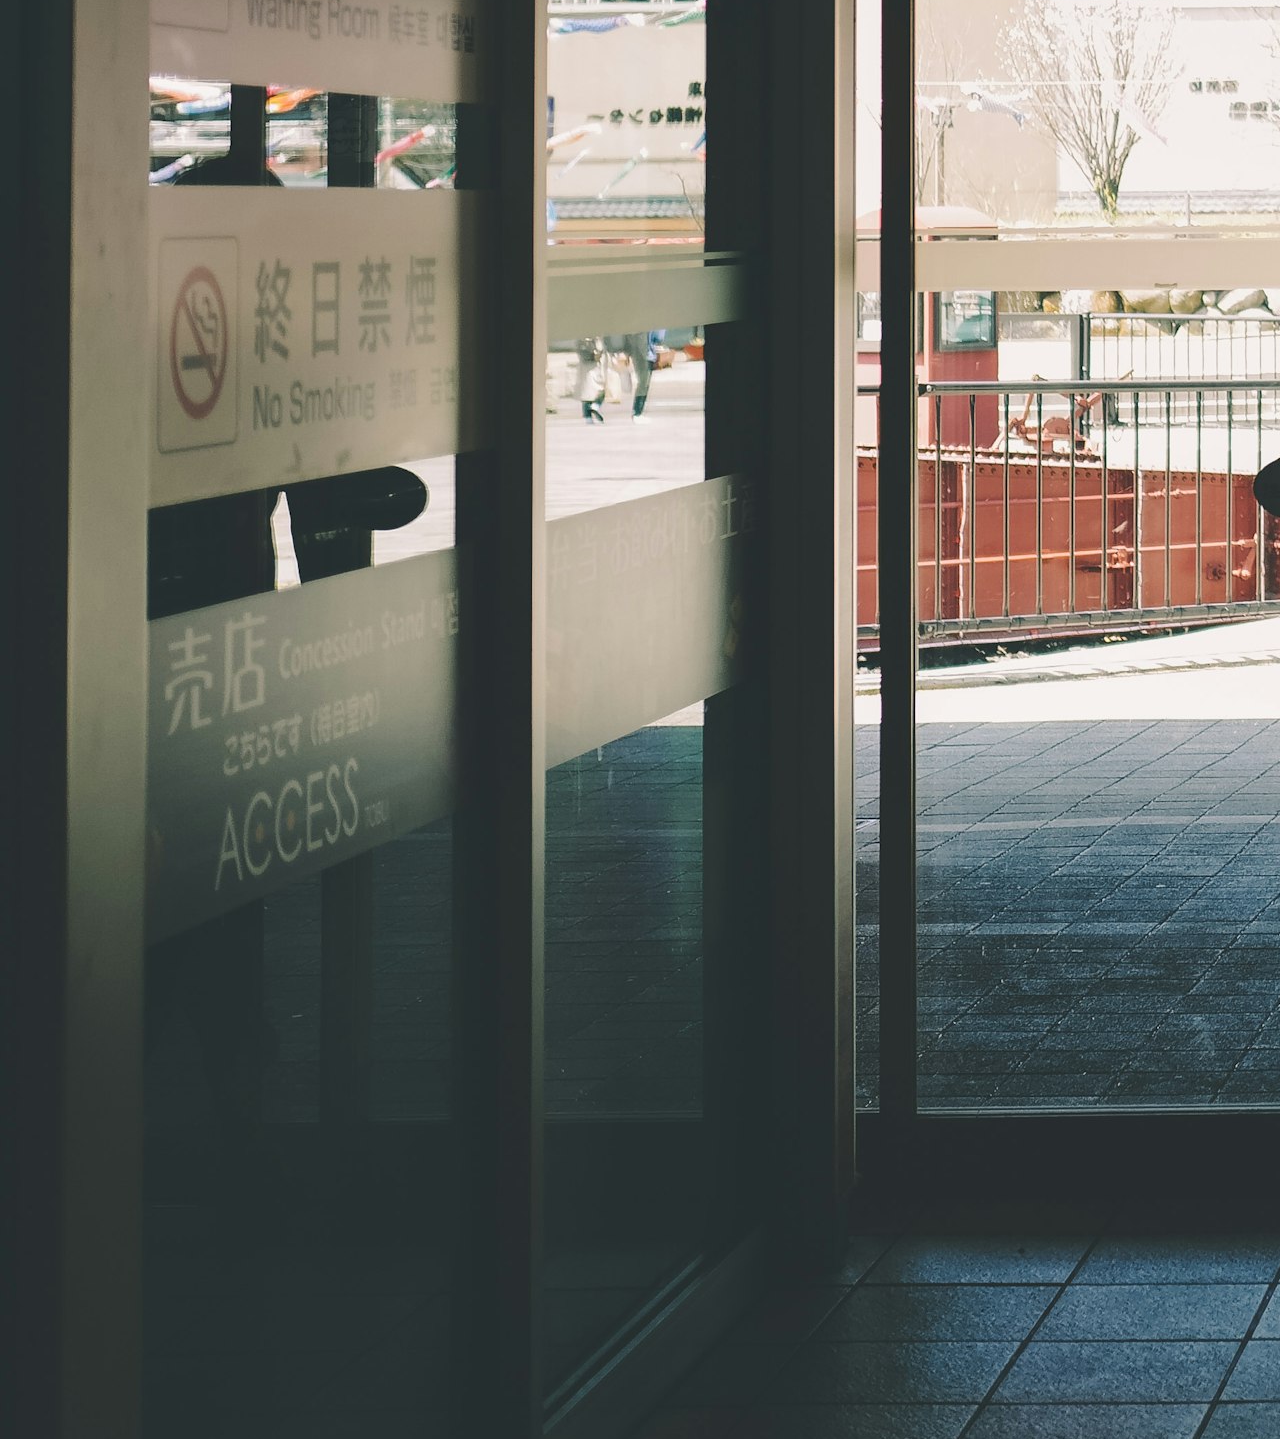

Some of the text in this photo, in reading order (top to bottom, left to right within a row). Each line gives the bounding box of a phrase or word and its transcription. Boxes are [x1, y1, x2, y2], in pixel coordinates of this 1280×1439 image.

[254, 254, 437, 364] 終日禁煙
[252, 383, 282, 432] No
[290, 376, 376, 426] Smoking
[165, 611, 269, 737] 売店
[279, 620, 376, 680] Concession
[382, 609, 426, 651] Stand
[214, 757, 361, 892] ACCESS
